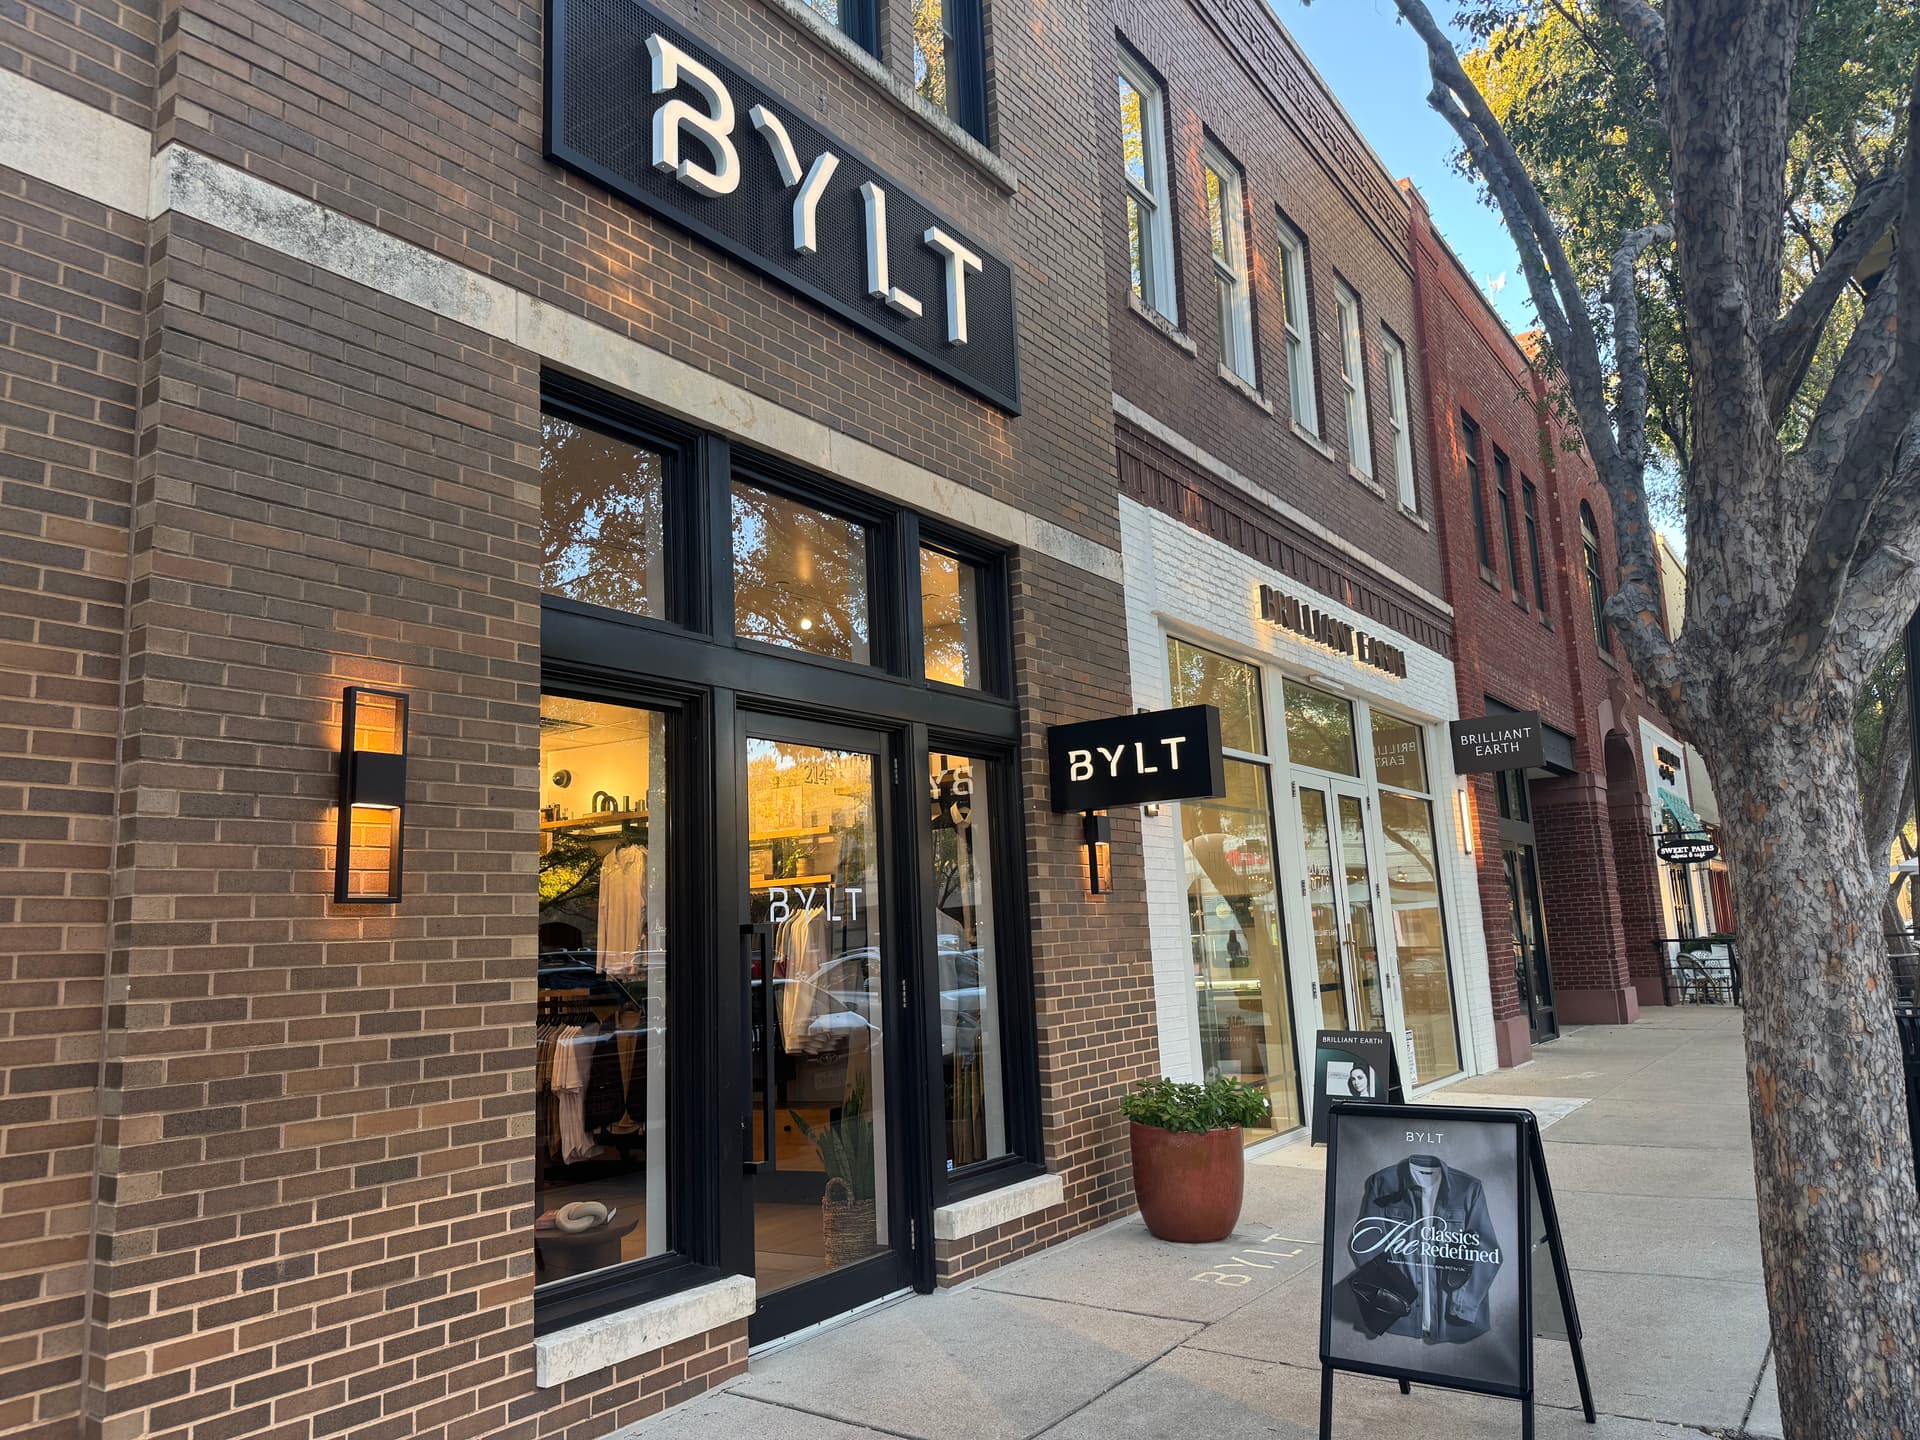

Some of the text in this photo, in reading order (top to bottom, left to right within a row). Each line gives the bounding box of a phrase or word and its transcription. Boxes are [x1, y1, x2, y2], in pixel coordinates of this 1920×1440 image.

[645, 33, 983, 346] BYLT
[1460, 727, 1532, 745] BRILLIANT
[1068, 736, 1186, 782] BYLT
[1475, 742, 1520, 757] EARTH
[1660, 844, 1715, 855] SWEET PARIS
[768, 887, 863, 922] BYLT
[1322, 1036, 1358, 1044] BRILLIANT
[1405, 1131, 1444, 1145] BYLT
[1350, 1216, 1480, 1255] The Classics
[1190, 1233, 1317, 1287] BYLT
[1420, 1242, 1500, 1264] Redefined
